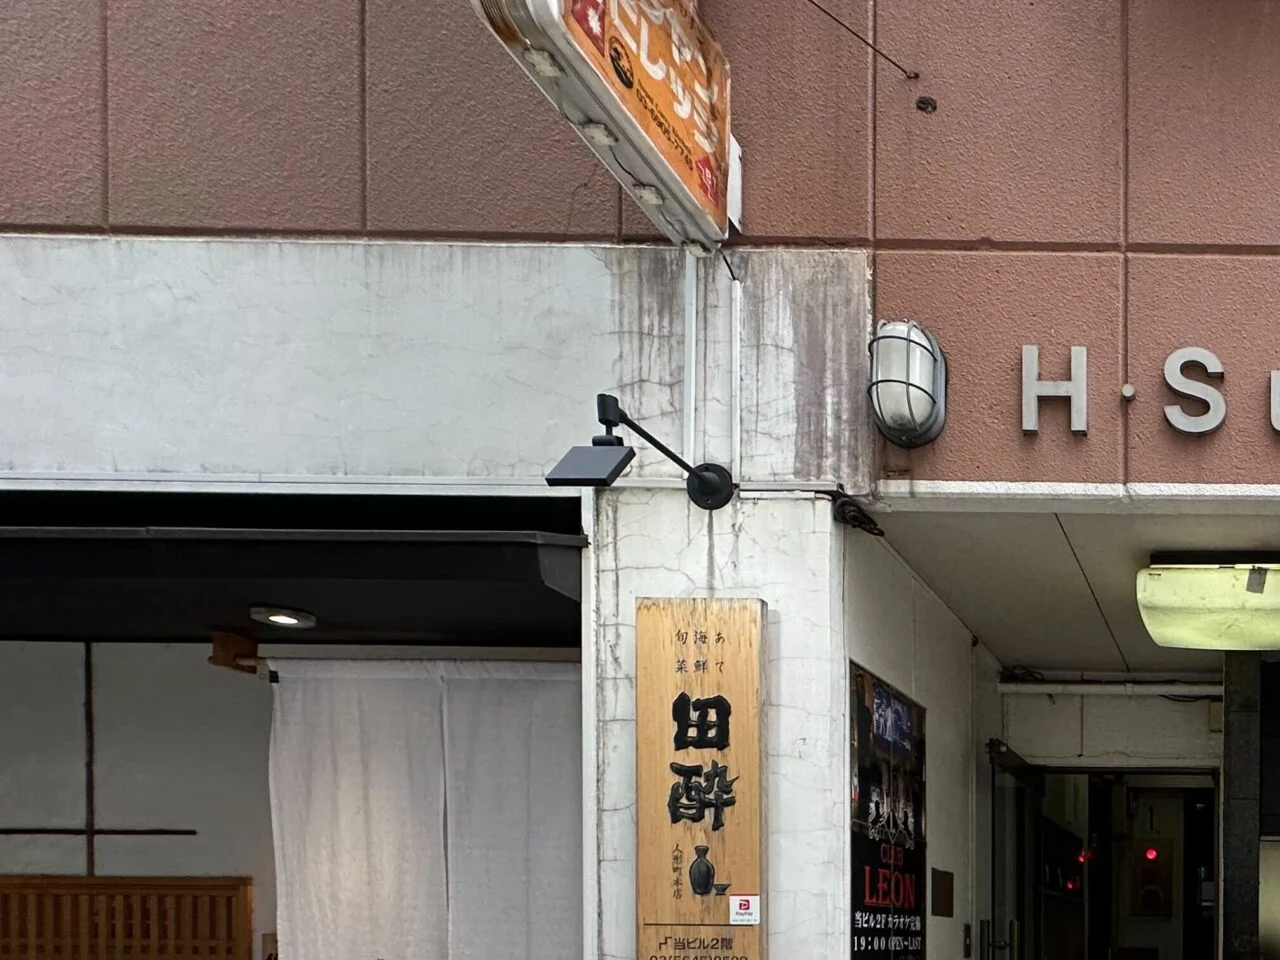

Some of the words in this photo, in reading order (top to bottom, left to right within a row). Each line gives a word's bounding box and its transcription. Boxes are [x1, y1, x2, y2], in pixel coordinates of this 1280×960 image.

[675, 629, 688, 674] 旬菜
[694, 630, 708, 674] 海鮮
[715, 631, 725, 674] あて
[667, 691, 740, 831] 田酔
[864, 865, 916, 909] LEON
[674, 937, 733, 950] 当ビル2階
[854, 936, 886, 951] 19:00
